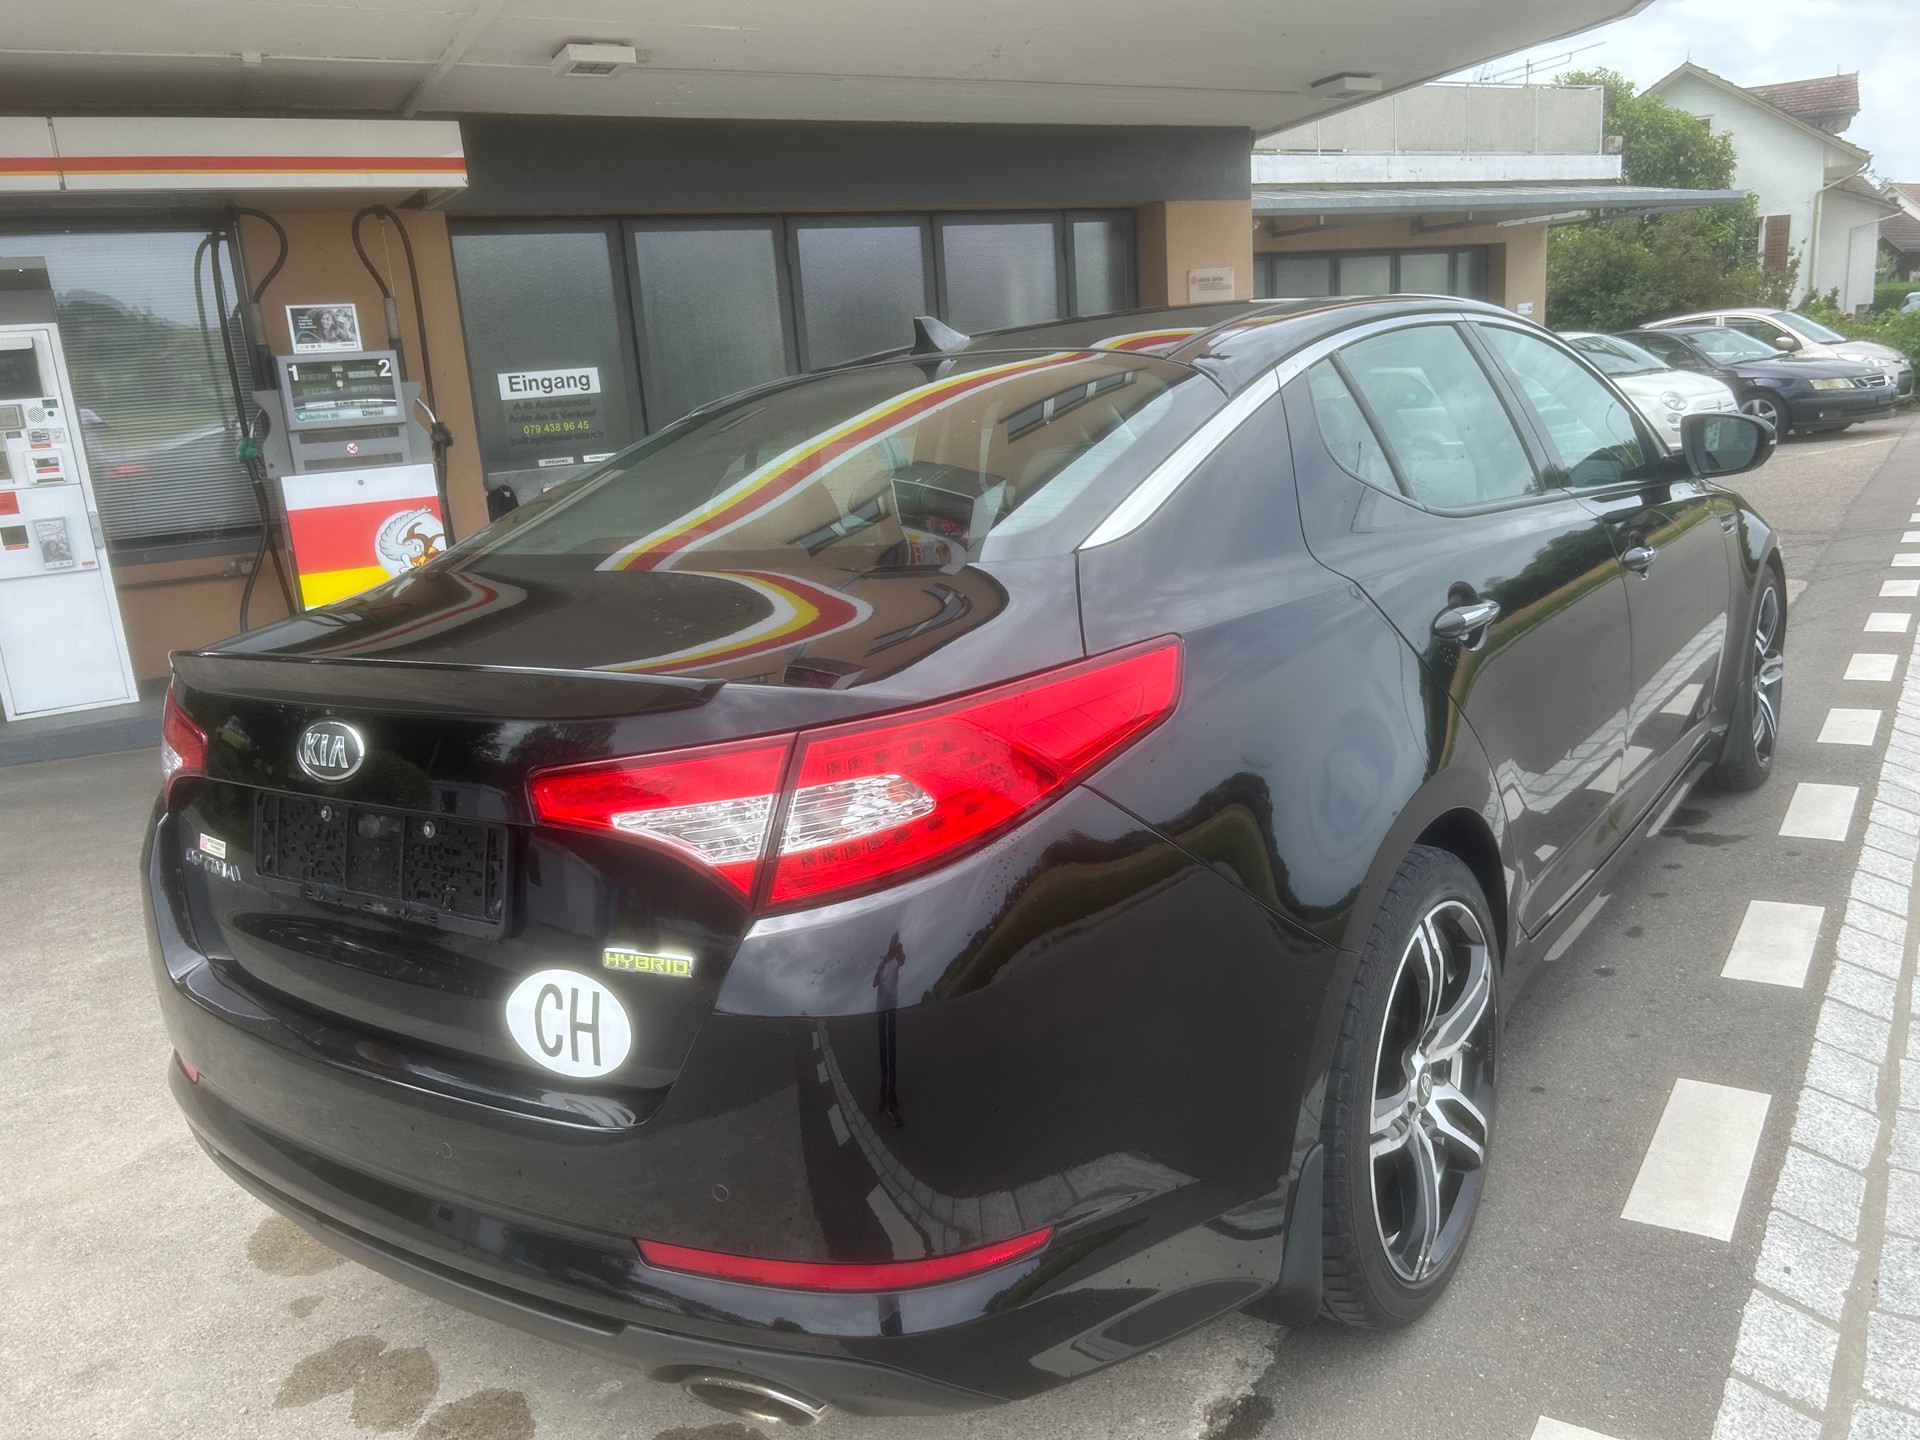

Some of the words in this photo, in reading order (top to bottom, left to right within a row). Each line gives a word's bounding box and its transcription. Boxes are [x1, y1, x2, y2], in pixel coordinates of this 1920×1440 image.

[288, 365, 299, 381] 1
[378, 359, 392, 377] 2
[508, 374, 591, 394] Eingang
[535, 397, 591, 409] Autohandel
[362, 409, 384, 417] Diesel
[509, 415, 532, 423] Auto
[533, 413, 548, 421] An
[551, 411, 558, 420] &
[560, 409, 597, 419] Verkauf
[523, 424, 541, 435] 079
[544, 423, 561, 433] 438
[563, 421, 575, 432] 96
[577, 420, 589, 430] 45
[304, 732, 349, 769] KIA
[604, 951, 689, 975] HYBRID
[534, 983, 602, 1067] CH
